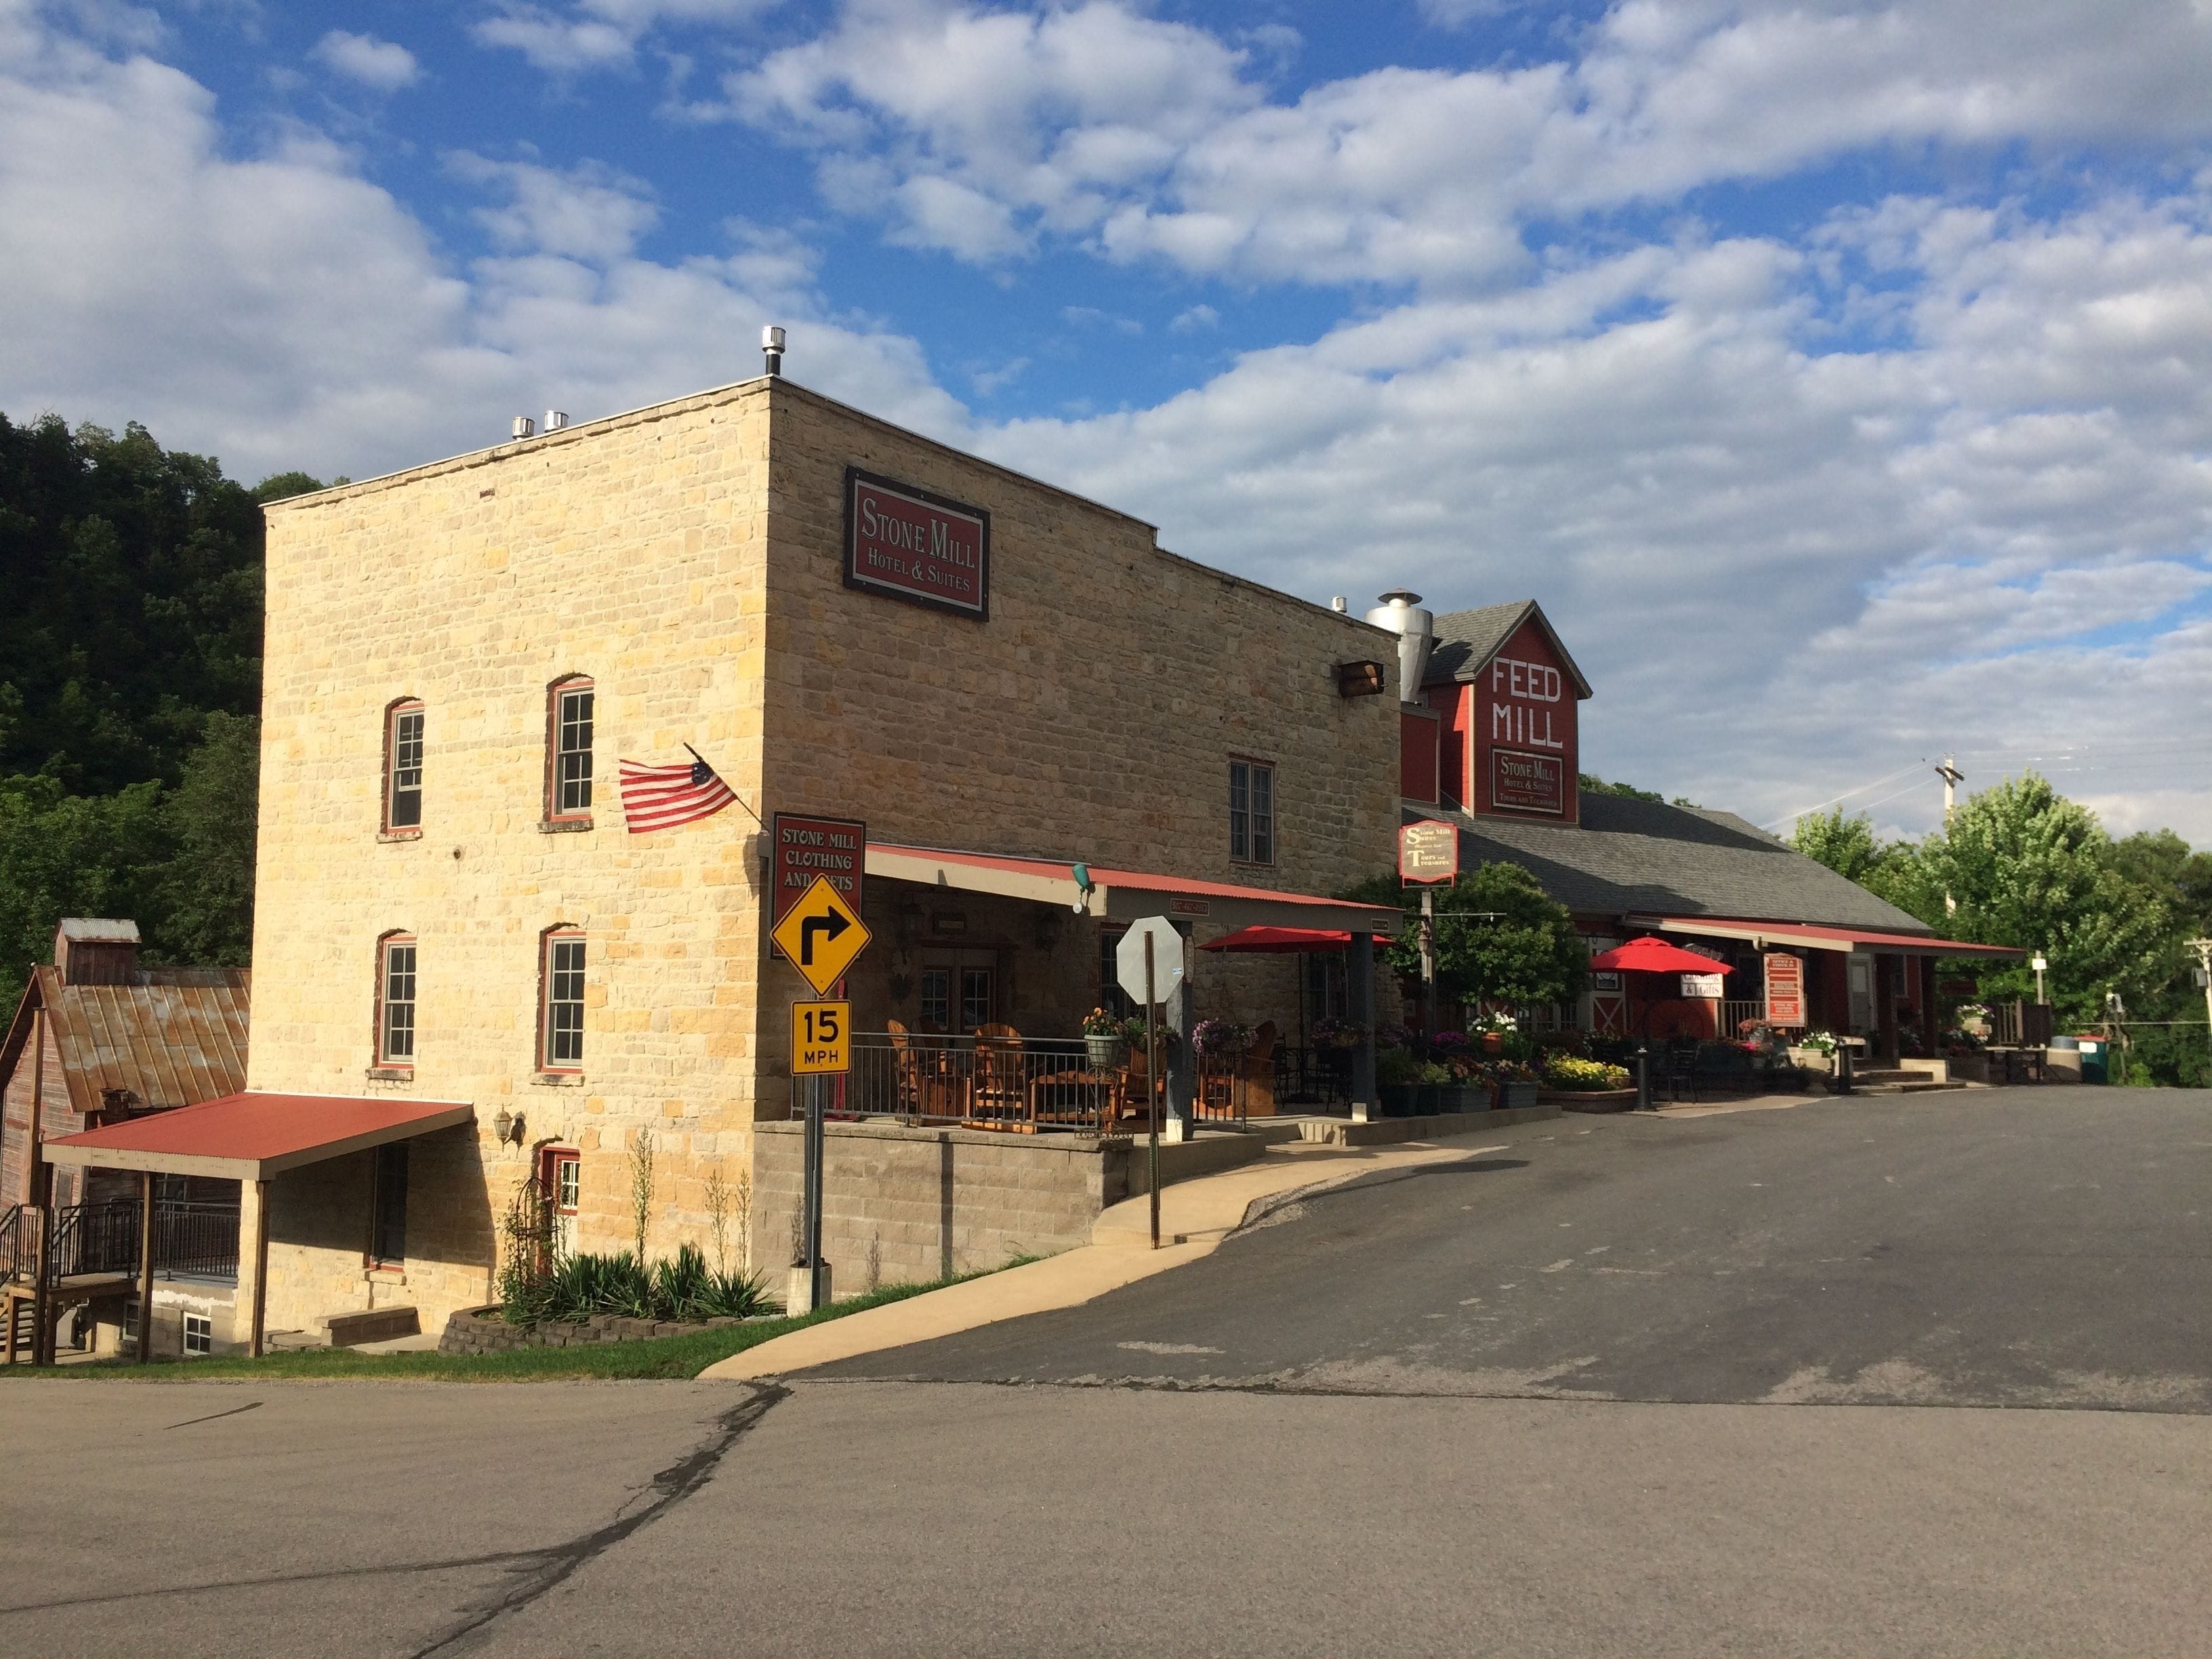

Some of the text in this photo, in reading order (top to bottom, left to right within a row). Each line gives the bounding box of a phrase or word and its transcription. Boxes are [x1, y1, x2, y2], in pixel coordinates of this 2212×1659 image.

[861, 497, 975, 569] STONE MILL
[868, 547, 970, 592] HOTEL & SUITES
[1493, 657, 1561, 703] FEED
[1493, 702, 1563, 749] MILL
[1500, 756, 1555, 781] STONE MILL
[1504, 778, 1553, 792] HOTEL & SUITES
[783, 828, 857, 849] STONE MILL
[786, 851, 853, 869] CLOTHING
[784, 872, 811, 887] AND
[1687, 985, 1719, 994] & Gifts
[804, 1010, 839, 1043] 15
[804, 1050, 838, 1064] MPH
